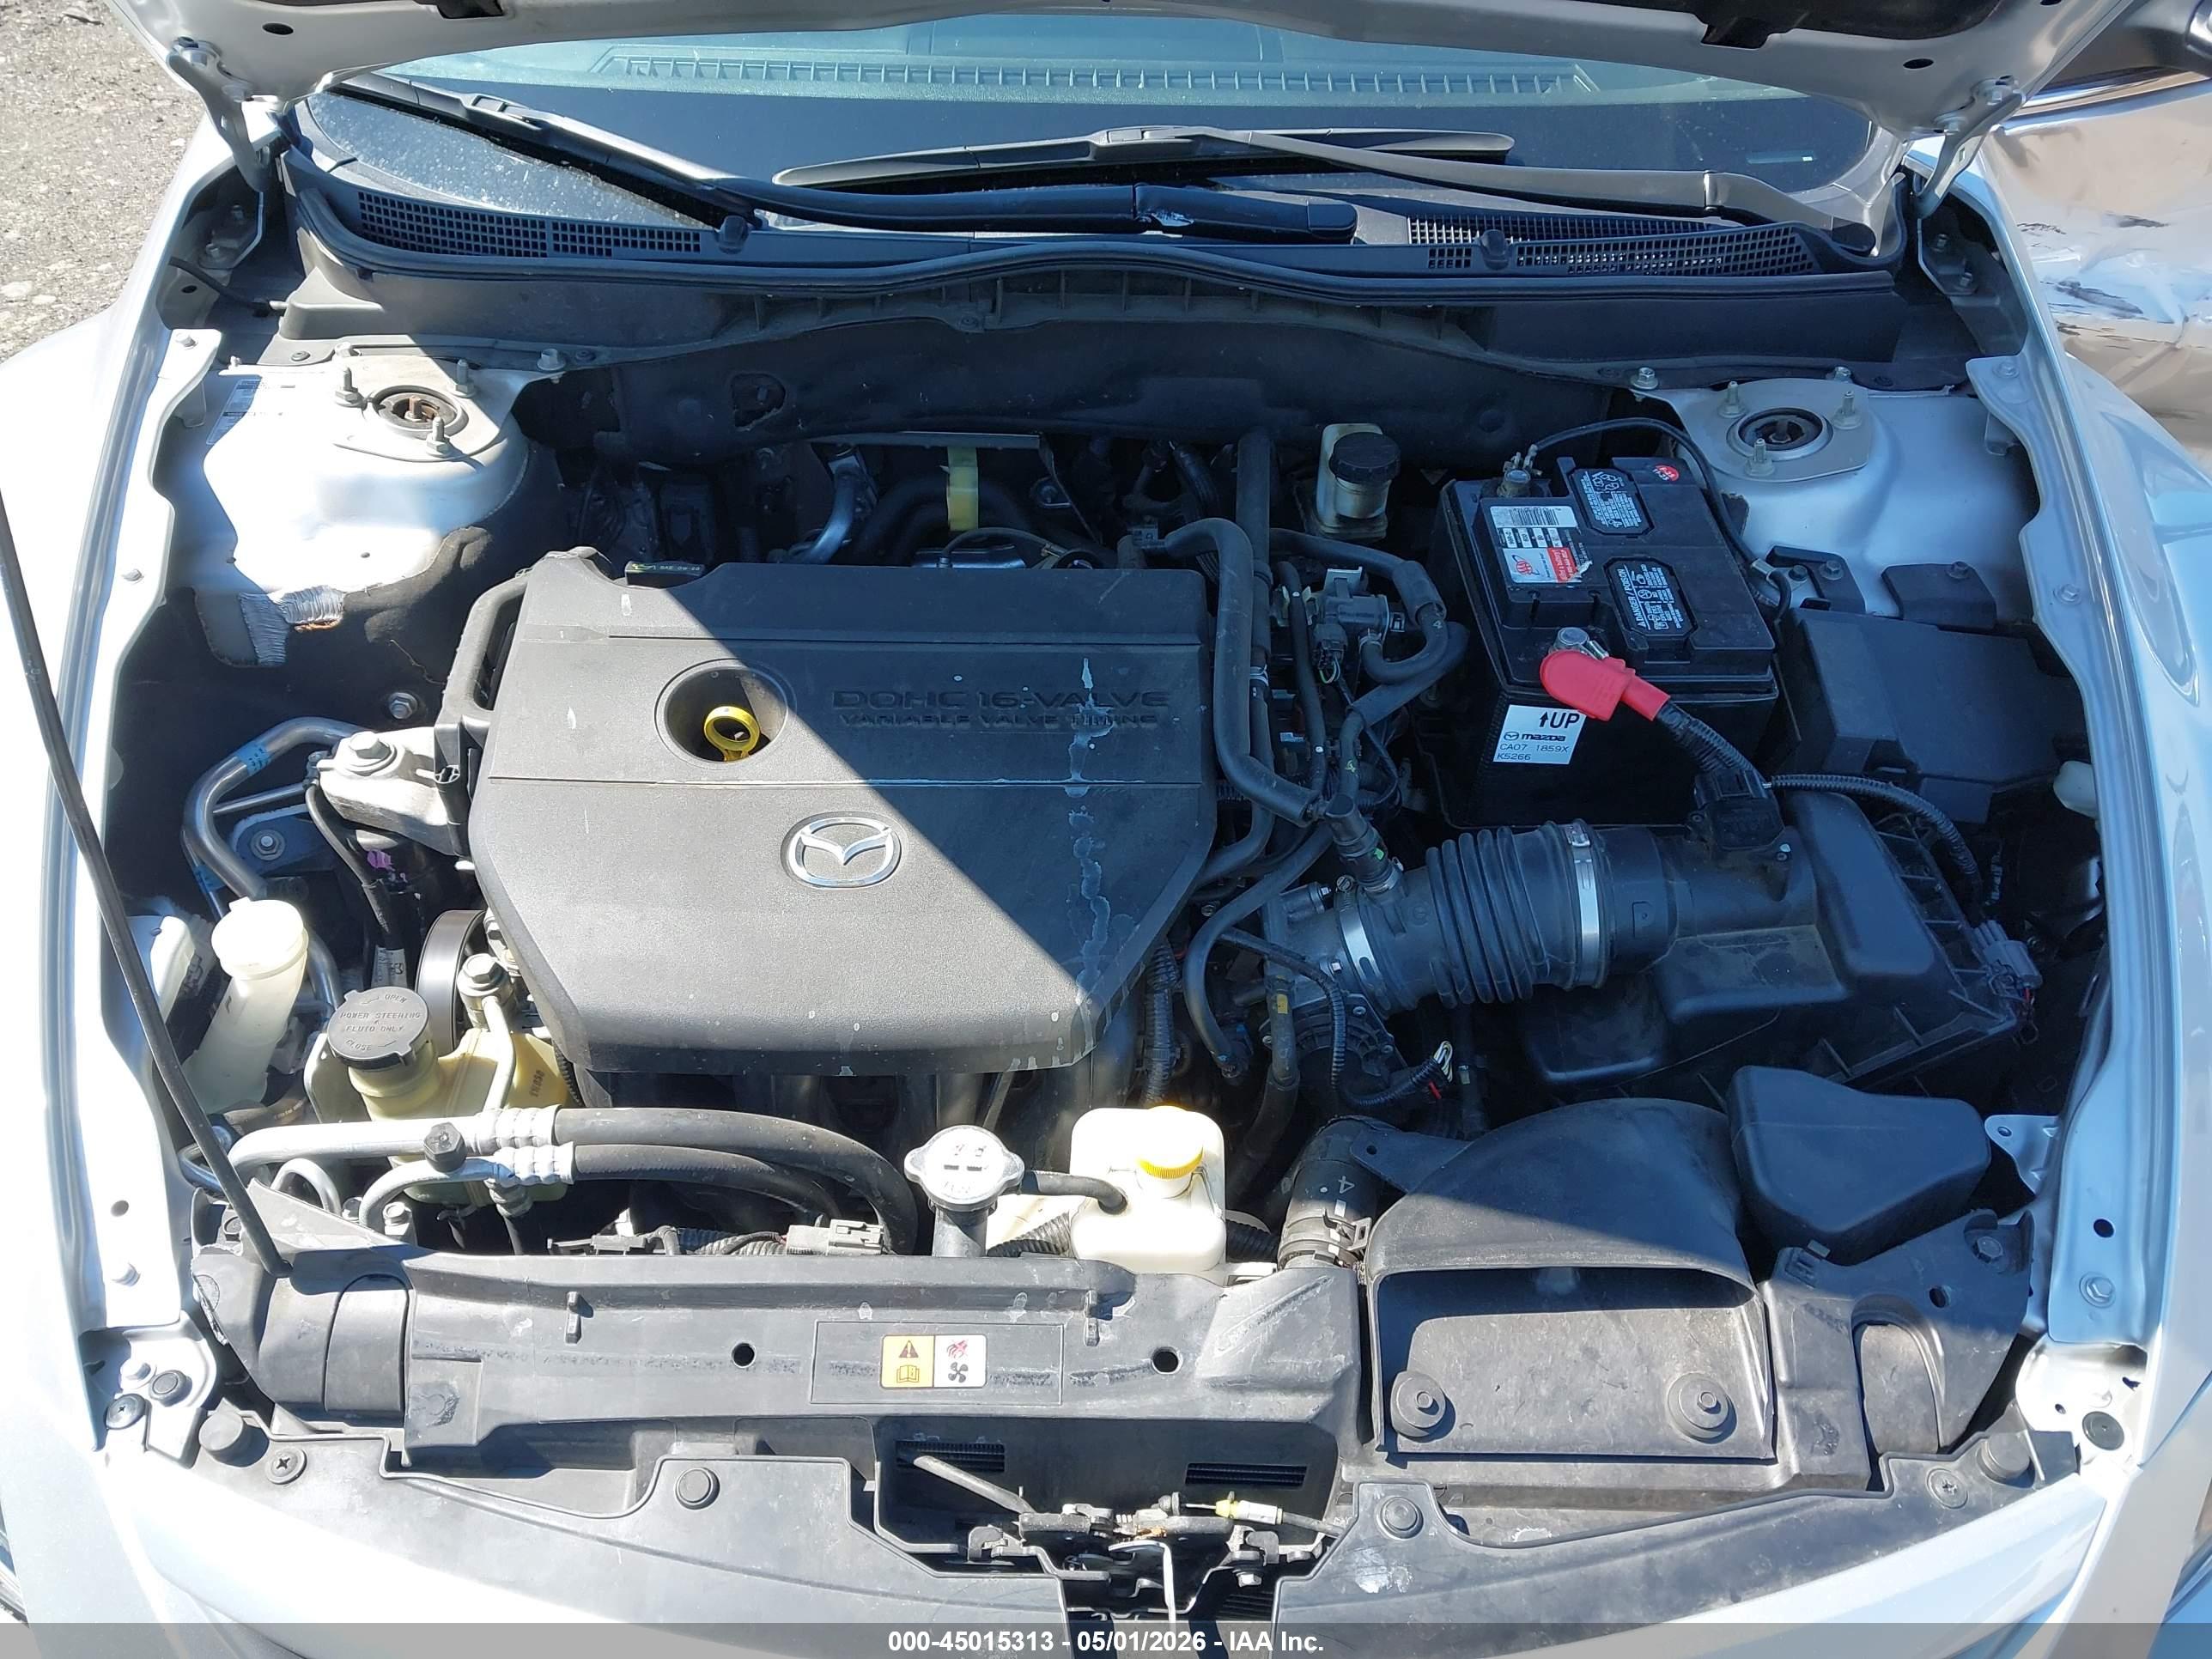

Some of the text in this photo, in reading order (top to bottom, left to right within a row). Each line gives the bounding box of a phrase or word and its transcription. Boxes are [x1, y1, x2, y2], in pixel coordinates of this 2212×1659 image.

[1617, 568, 1632, 591] POISON
[1628, 596, 1644, 622] DANGER
[833, 690, 1170, 709] DOHC 16-VALVE
[839, 714, 971, 729] VARIABLE
[979, 714, 1060, 729] VALVE
[1549, 711, 1581, 729] UP
[1499, 743, 1570, 753] CA07 1859X
[1497, 752, 1531, 761] K5266
[384, 994, 408, 1003] OPEN
[345, 1039, 372, 1051] CLOSE
